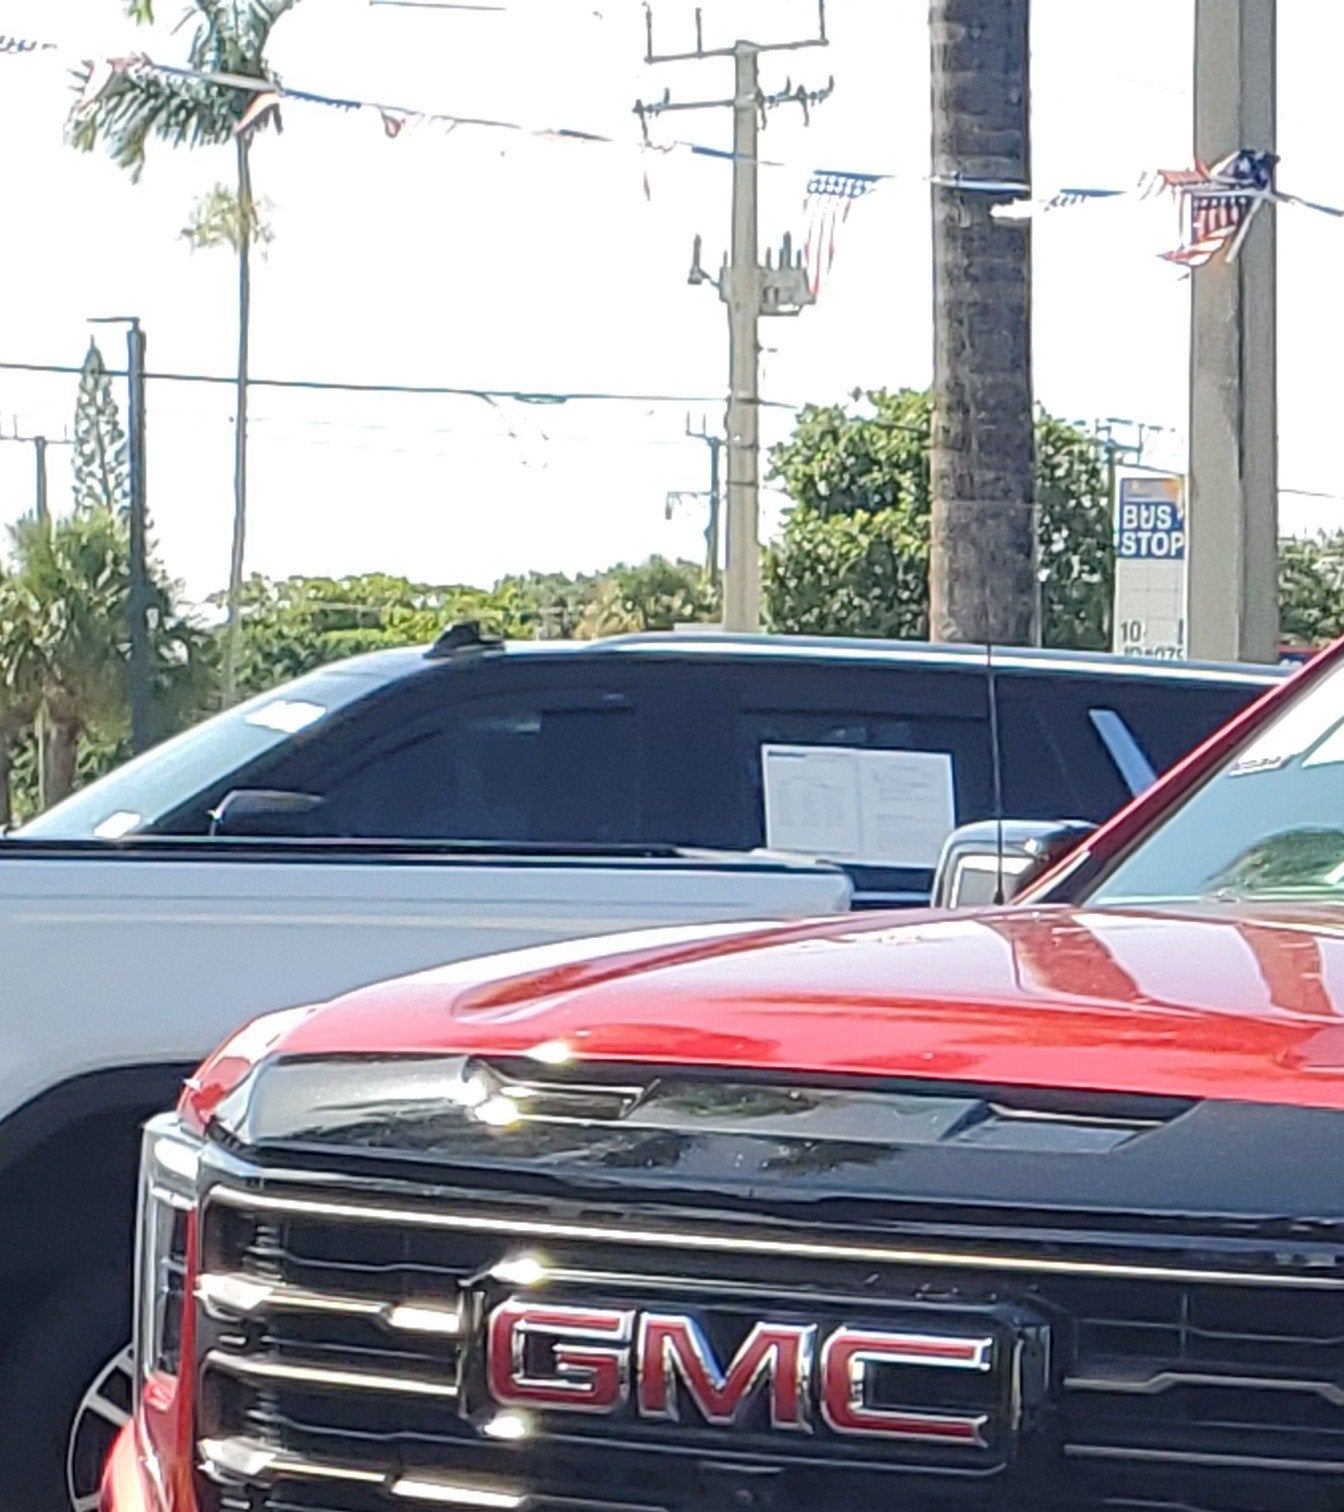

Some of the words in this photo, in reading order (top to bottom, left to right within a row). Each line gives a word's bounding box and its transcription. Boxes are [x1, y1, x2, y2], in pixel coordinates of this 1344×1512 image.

[1123, 505, 1172, 530] BUS
[1121, 531, 1184, 556] STOP
[487, 1300, 993, 1449] GMC
